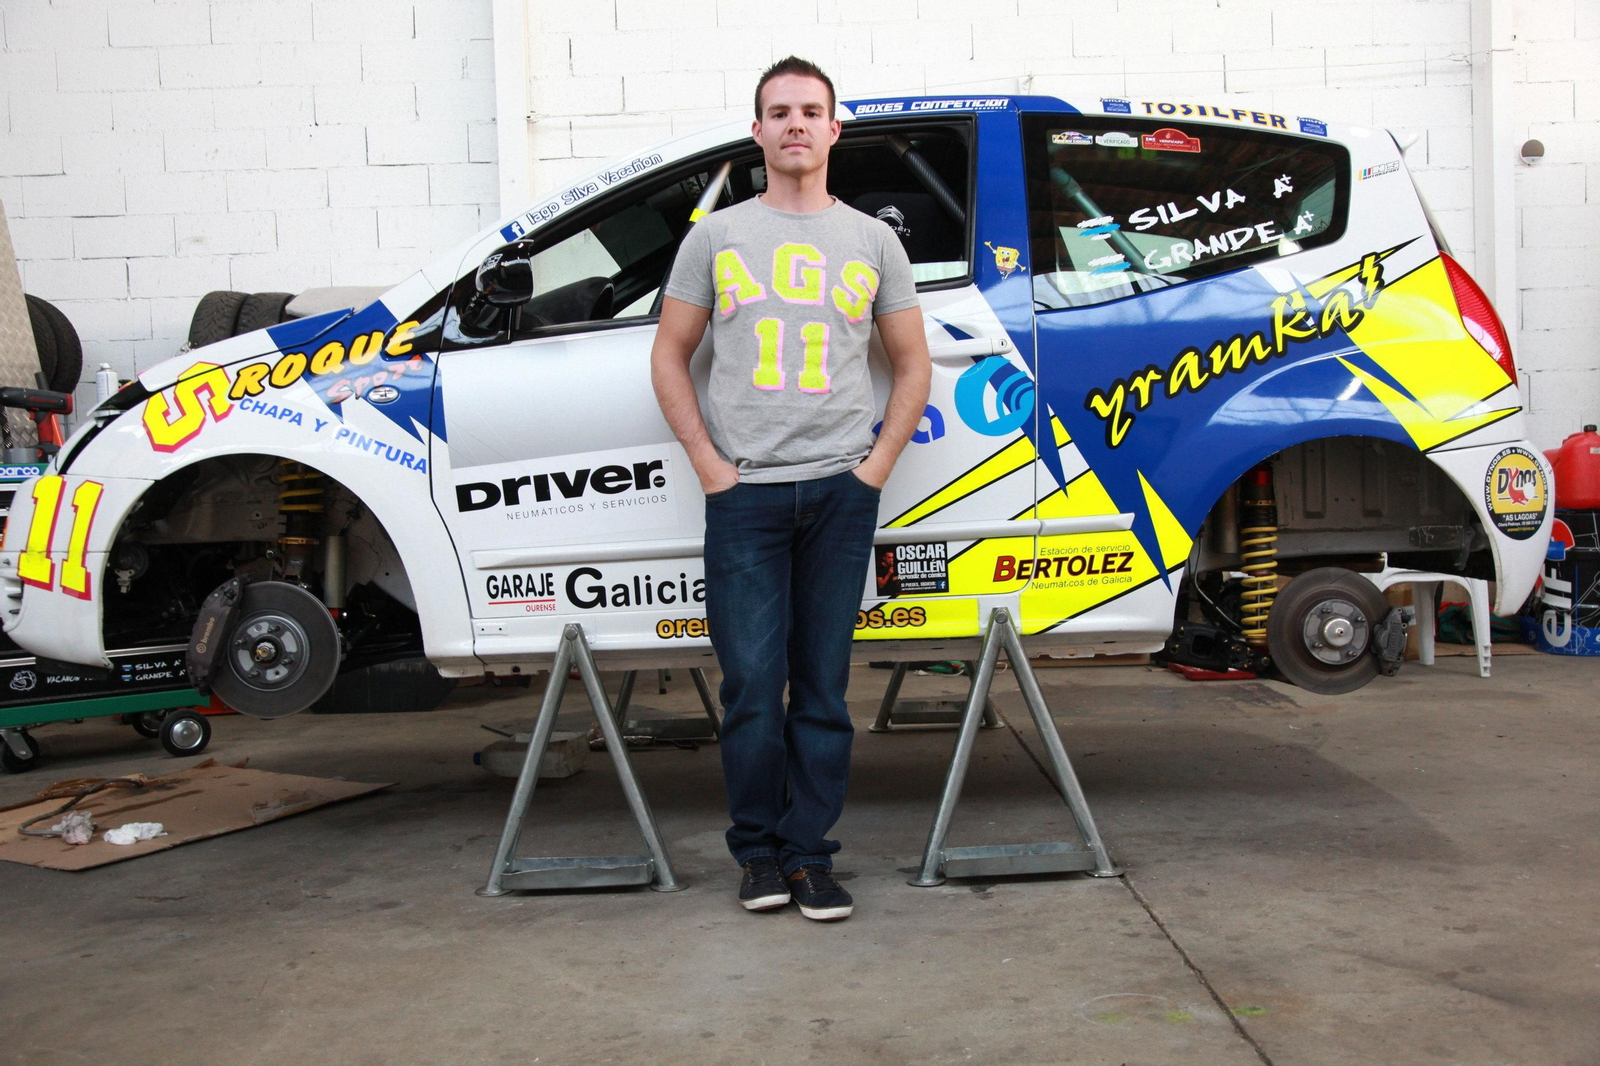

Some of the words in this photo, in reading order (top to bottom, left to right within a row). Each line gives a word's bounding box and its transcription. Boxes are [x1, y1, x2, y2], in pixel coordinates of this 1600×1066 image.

[855, 102, 904, 115] BOXES
[910, 99, 1009, 111] COMPETICION
[1141, 101, 1288, 130] TOSILFER
[561, 181, 599, 206] Silva
[597, 153, 663, 186] Vacañon
[1128, 188, 1246, 231] SILVA
[1144, 220, 1285, 270] GRANDE
[714, 242, 880, 323] AGS
[228, 320, 422, 401] ROQUE
[753, 317, 831, 394] 11
[239, 398, 303, 427] CHAPA
[314, 418, 329, 433] Y
[335, 427, 427, 474] PINTURA
[506, 503, 584, 521] NEUMÁTICOS
[589, 502, 596, 511] Y
[602, 494, 668, 510] SERVICIOS
[18, 474, 104, 601] 11
[1081, 545, 1093, 554] de
[1096, 544, 1131, 553] servicio
[895, 543, 946, 561] OSCAR
[897, 559, 946, 575] GUILLÉN
[992, 551, 1135, 582] BERTOLEZ
[1090, 576, 1099, 585] de
[1101, 575, 1133, 585] Galicia
[486, 572, 555, 600] GARAJE
[525, 603, 556, 613] OURENSE
[200, 617, 215, 644] brembo
[134, 661, 167, 671] SILVA
[135, 671, 174, 681] GRANDE
